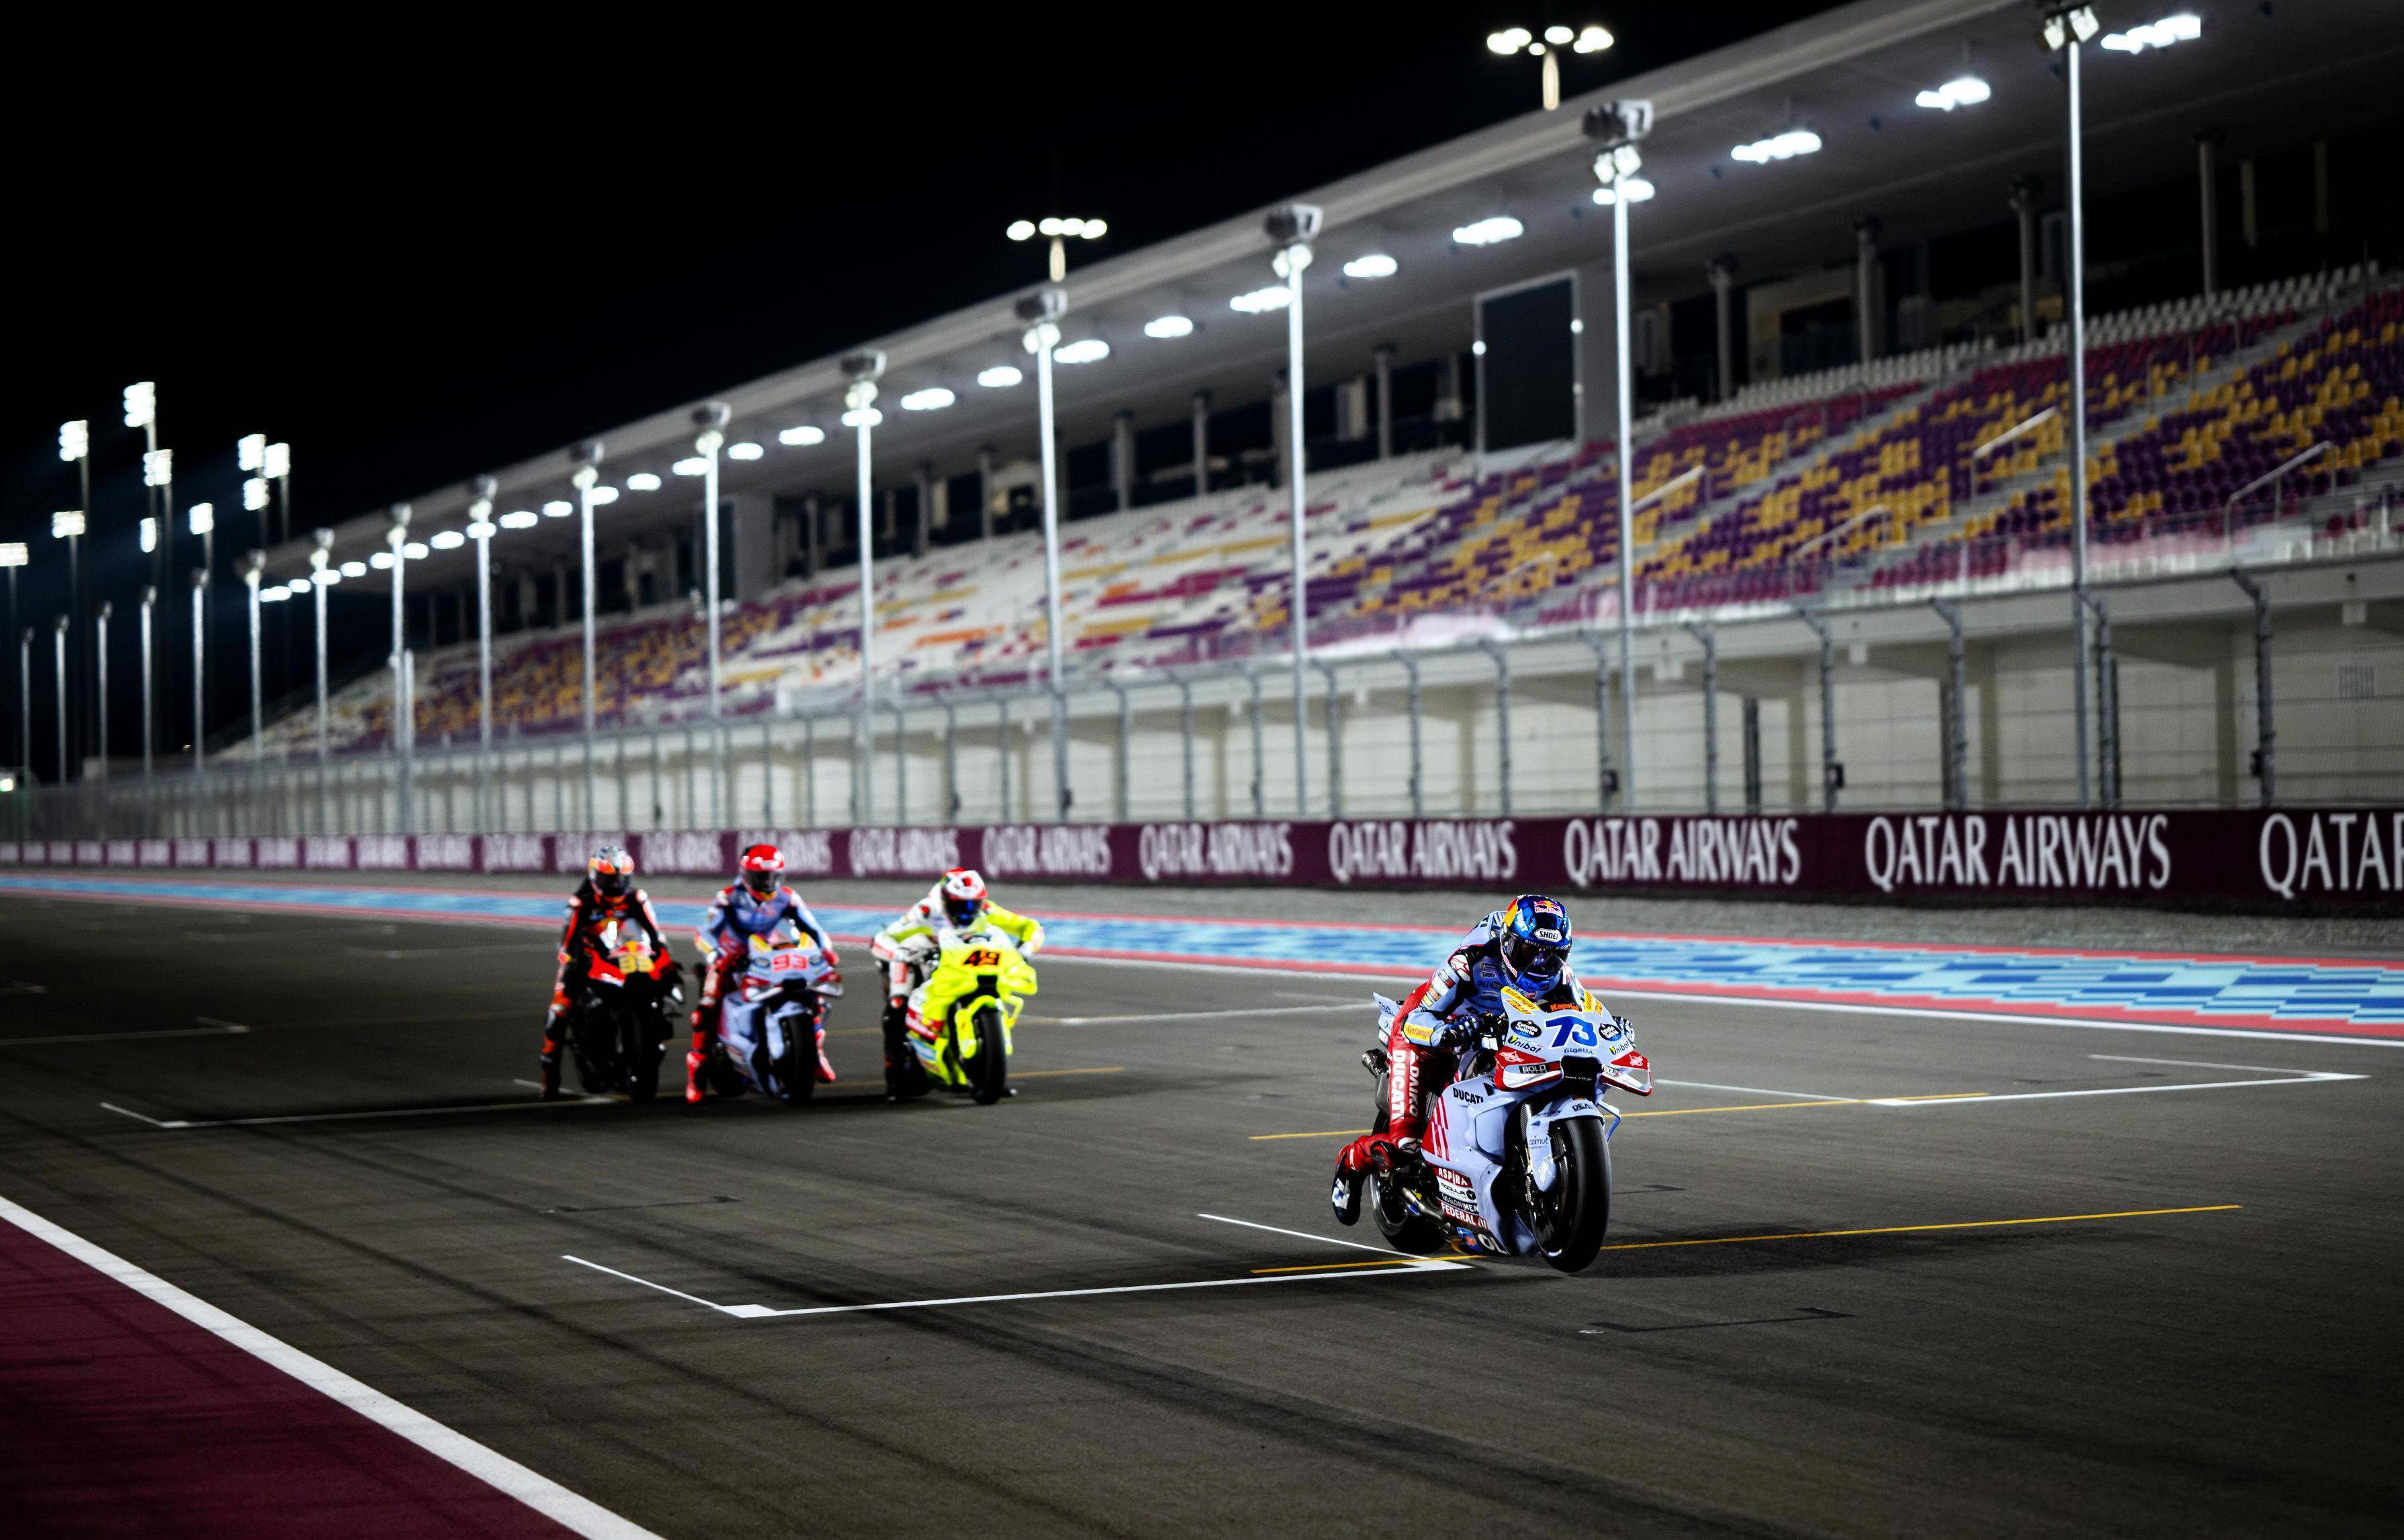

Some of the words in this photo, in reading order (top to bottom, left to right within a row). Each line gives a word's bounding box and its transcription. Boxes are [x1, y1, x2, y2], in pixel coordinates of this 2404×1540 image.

[1329, 821, 1407, 884] QATAR
[1411, 820, 1517, 878] AIRWAYS
[1564, 818, 1661, 887] QATAR
[1666, 818, 1799, 883] AIRWAYS
[1865, 816, 1989, 892] QATAR
[1998, 814, 2171, 889] AIRWAYS
[1539, 930, 1559, 940] SHOEI
[772, 954, 808, 972] 93
[963, 949, 1001, 967] 49
[1545, 1015, 1598, 1048] 73
[1508, 1035, 1542, 1053] Unibat
[1522, 1064, 1546, 1073] BOLD
[1453, 1087, 1483, 1104] DUCATI
[1441, 1202, 1476, 1226] FEDERAL
